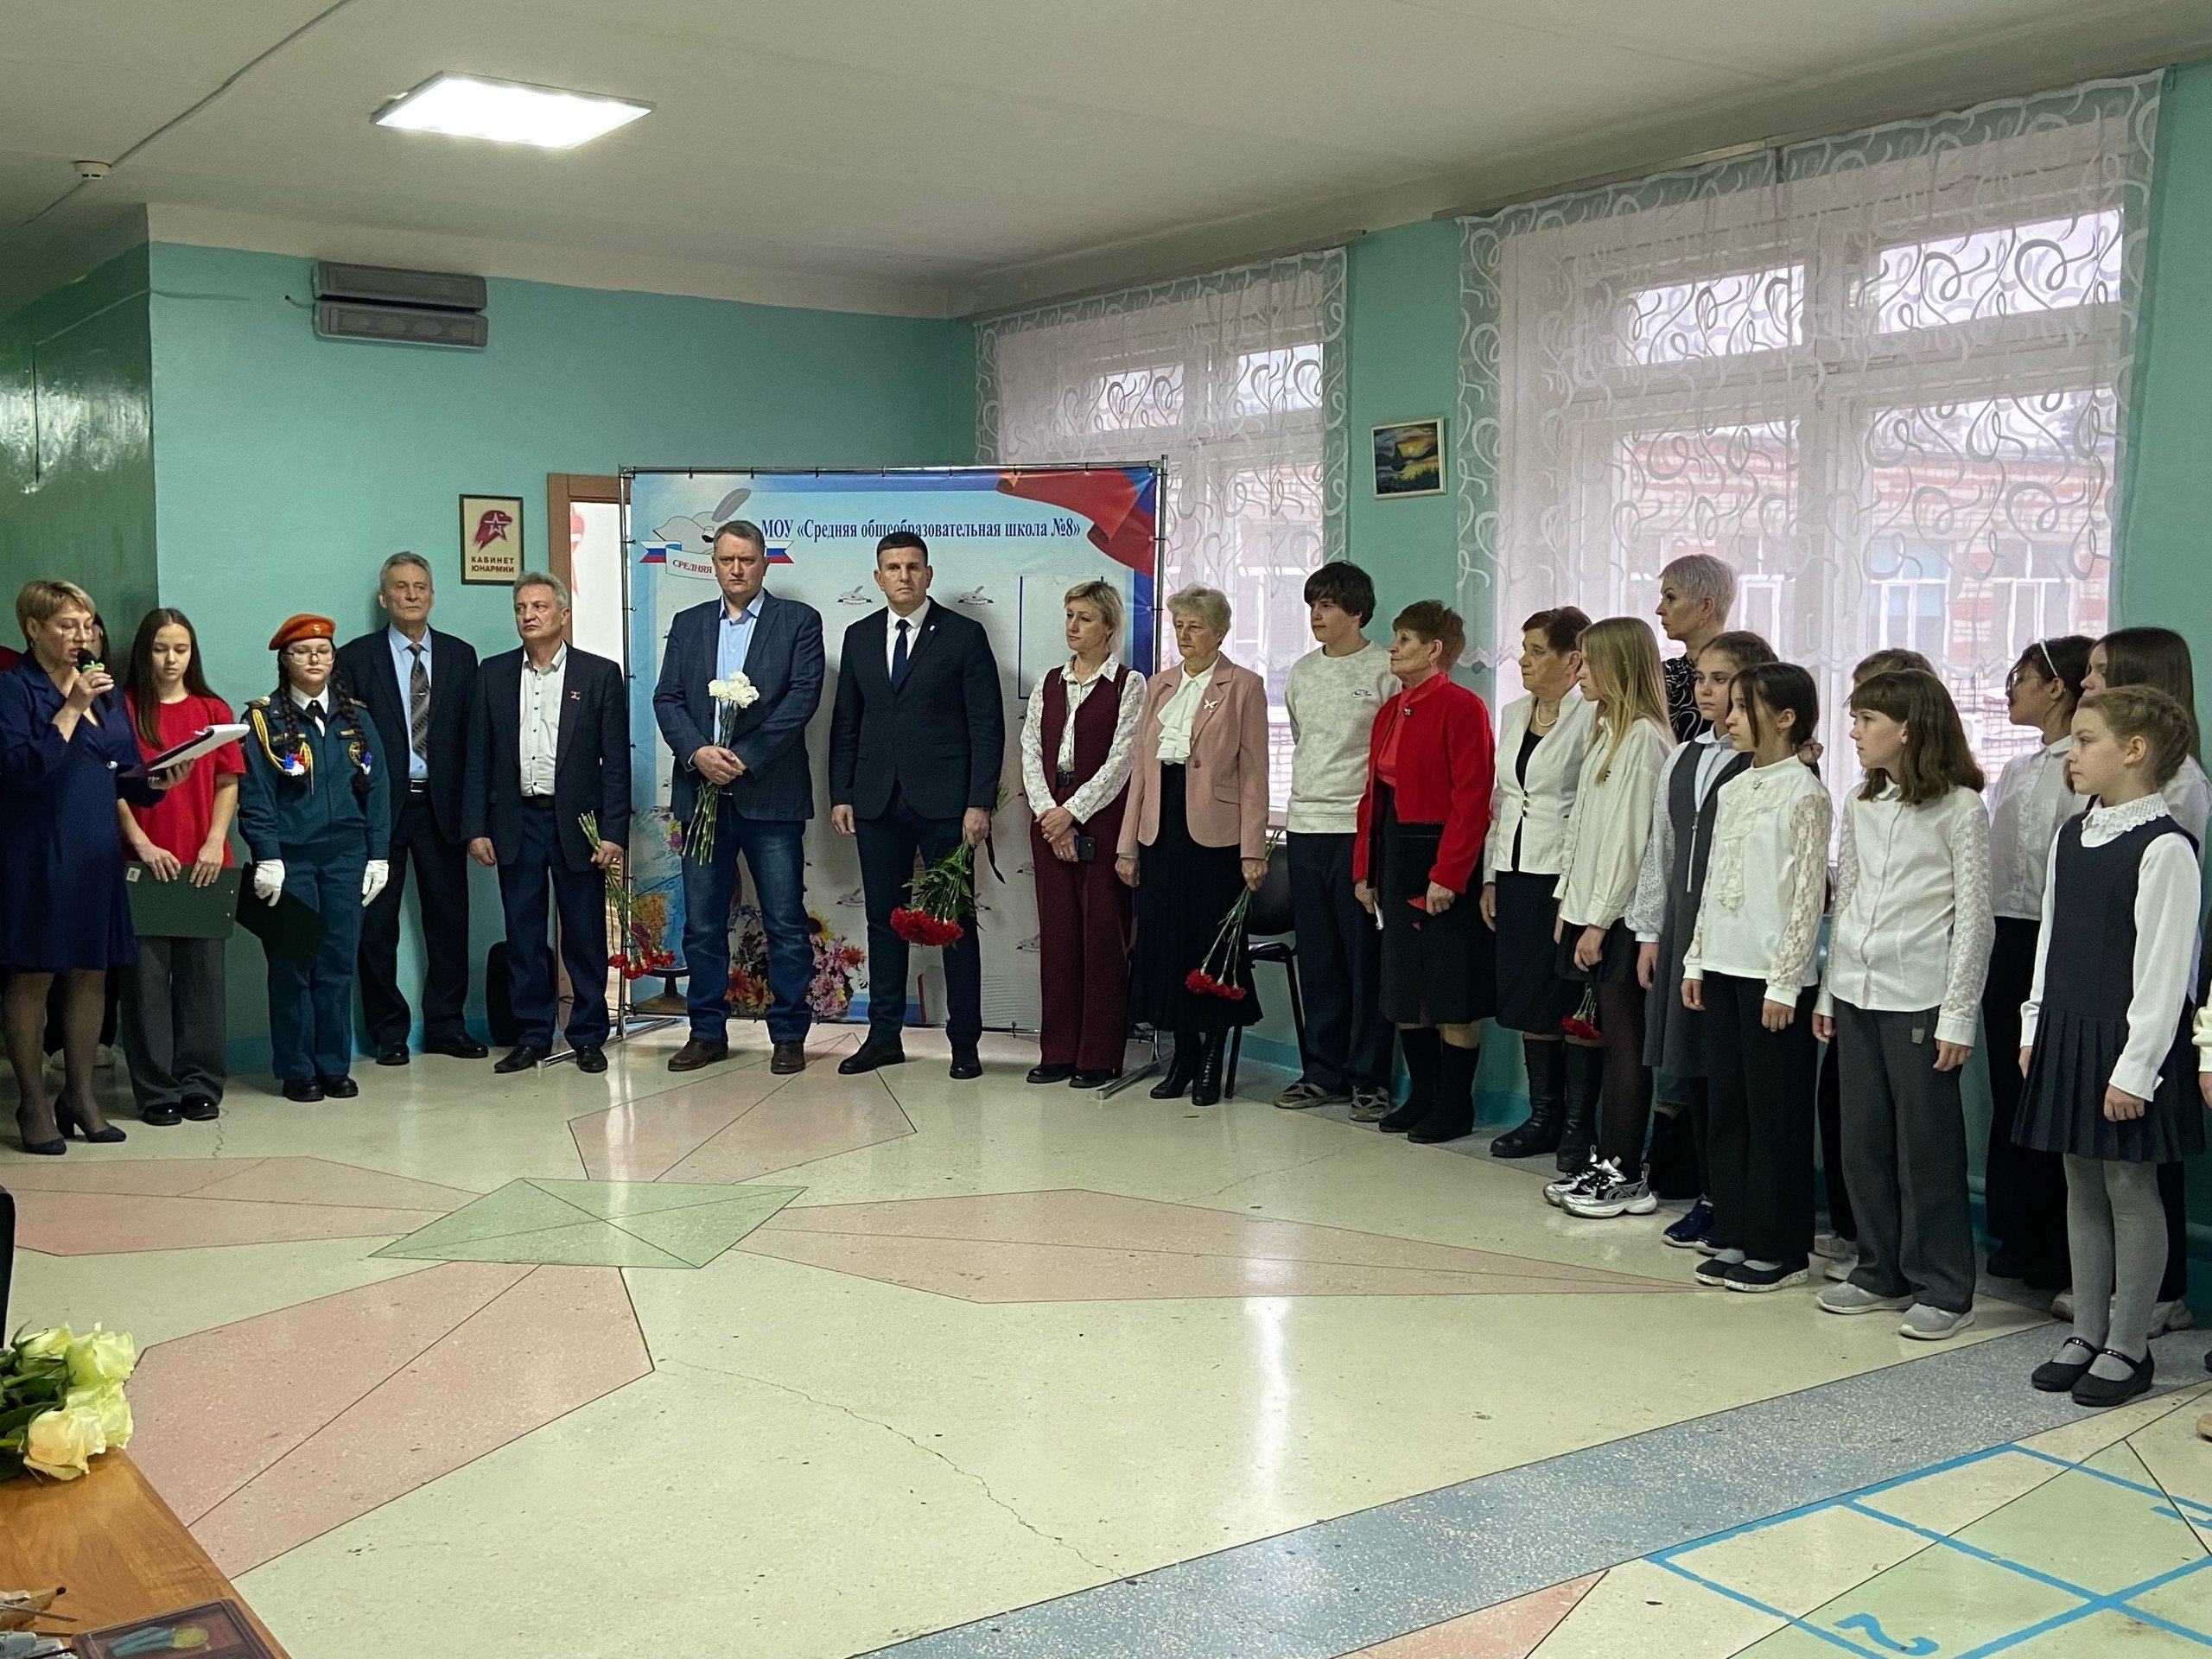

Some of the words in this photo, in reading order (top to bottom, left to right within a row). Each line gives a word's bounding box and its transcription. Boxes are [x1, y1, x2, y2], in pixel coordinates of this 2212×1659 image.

[762, 519, 793, 537] МОУ
[797, 519, 857, 543] «Средняя
[1005, 523, 1048, 537] школа
[1051, 518, 1081, 537] №8»
[471, 556, 515, 564] КАБИНЕТ
[471, 564, 515, 573] ЮНАРМИИ
[672, 559, 713, 574] СРЕДНЯЯ
